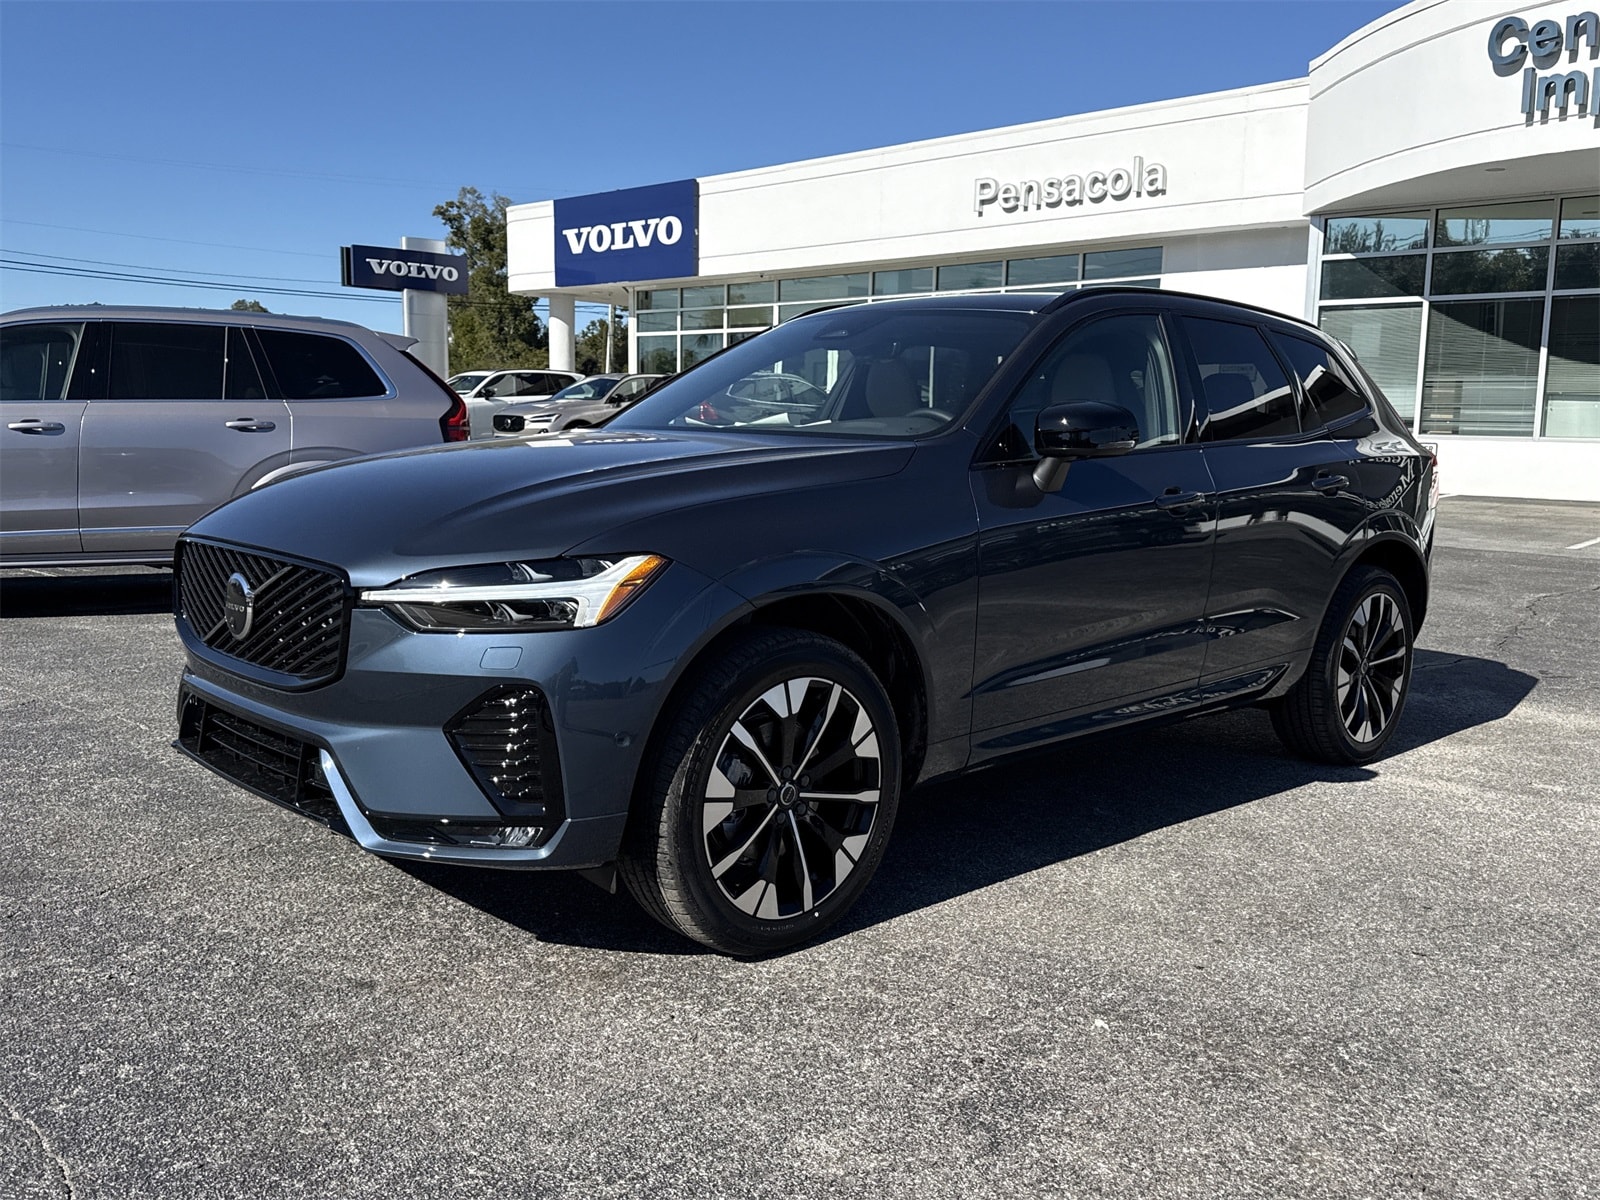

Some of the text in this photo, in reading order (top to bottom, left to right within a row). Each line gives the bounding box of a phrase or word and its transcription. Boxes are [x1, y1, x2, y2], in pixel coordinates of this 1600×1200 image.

[1488, 11, 1600, 67] Cen
[974, 156, 1167, 215] Pensacola
[563, 215, 683, 255] VOLVO
[365, 258, 459, 282] VOLVO
